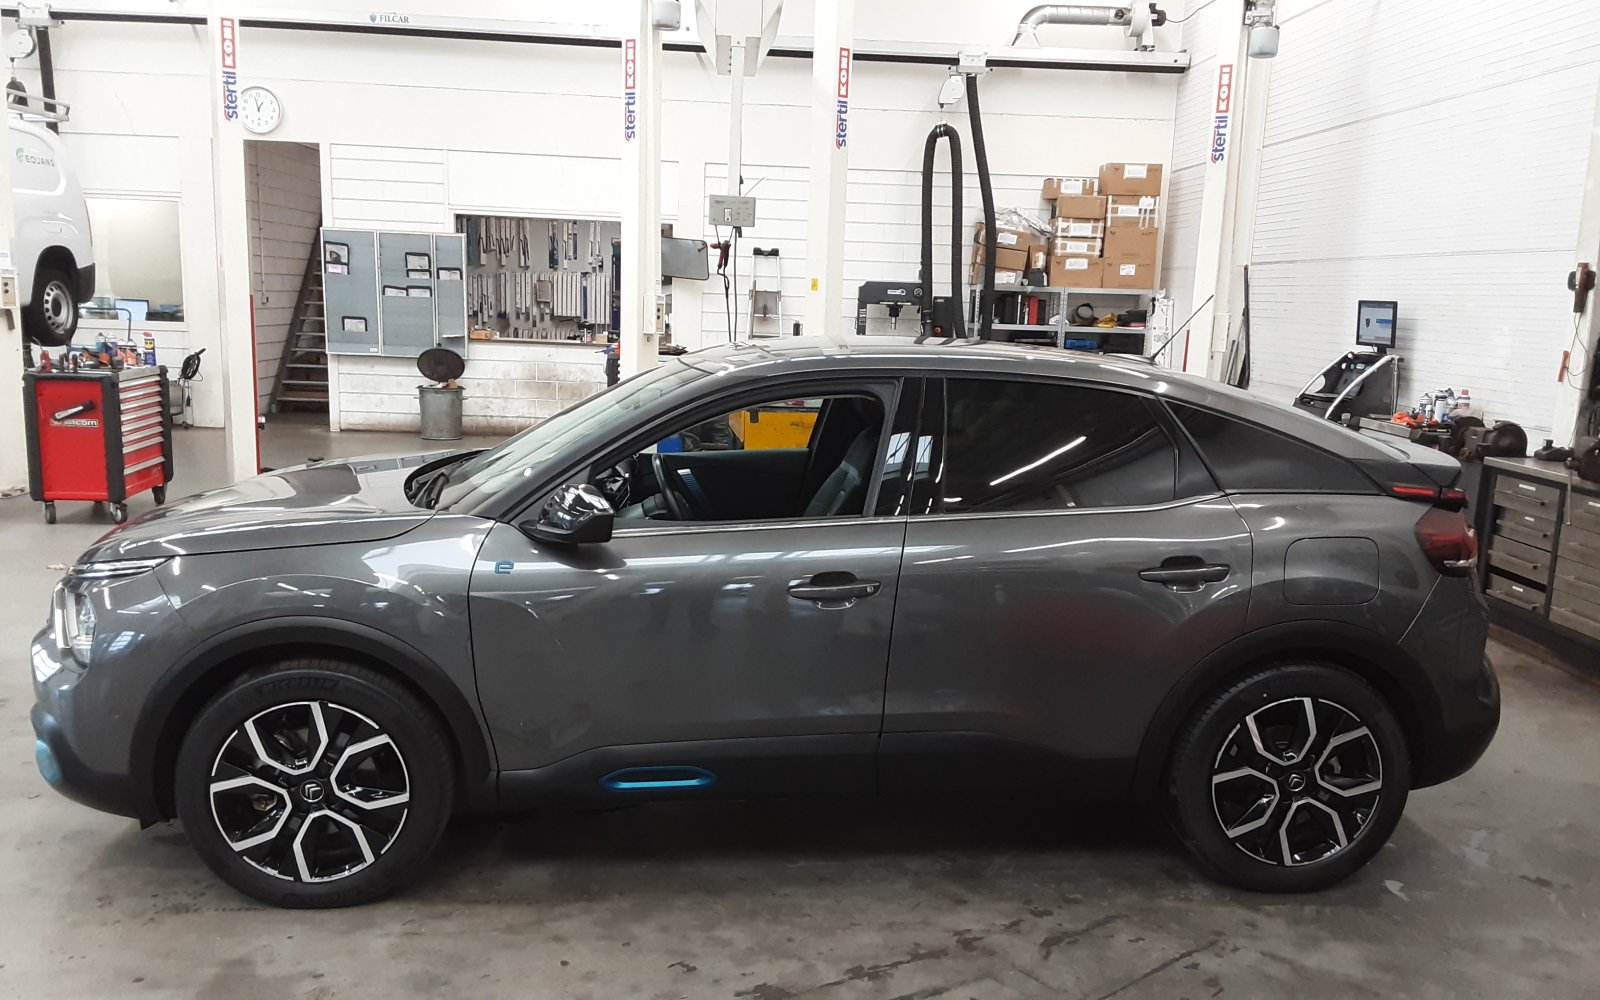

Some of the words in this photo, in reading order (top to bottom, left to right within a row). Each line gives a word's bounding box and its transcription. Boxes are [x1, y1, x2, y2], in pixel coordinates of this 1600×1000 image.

[222, 19, 235, 67] KONI
[379, 14, 410, 24] FILCAR
[625, 40, 635, 88] KONI
[839, 49, 849, 97] KONI
[222, 71, 238, 121] stertil
[1217, 66, 1231, 112] KONI
[625, 92, 635, 141] stertil
[836, 100, 848, 149] stertil
[1211, 115, 1228, 164] stertil
